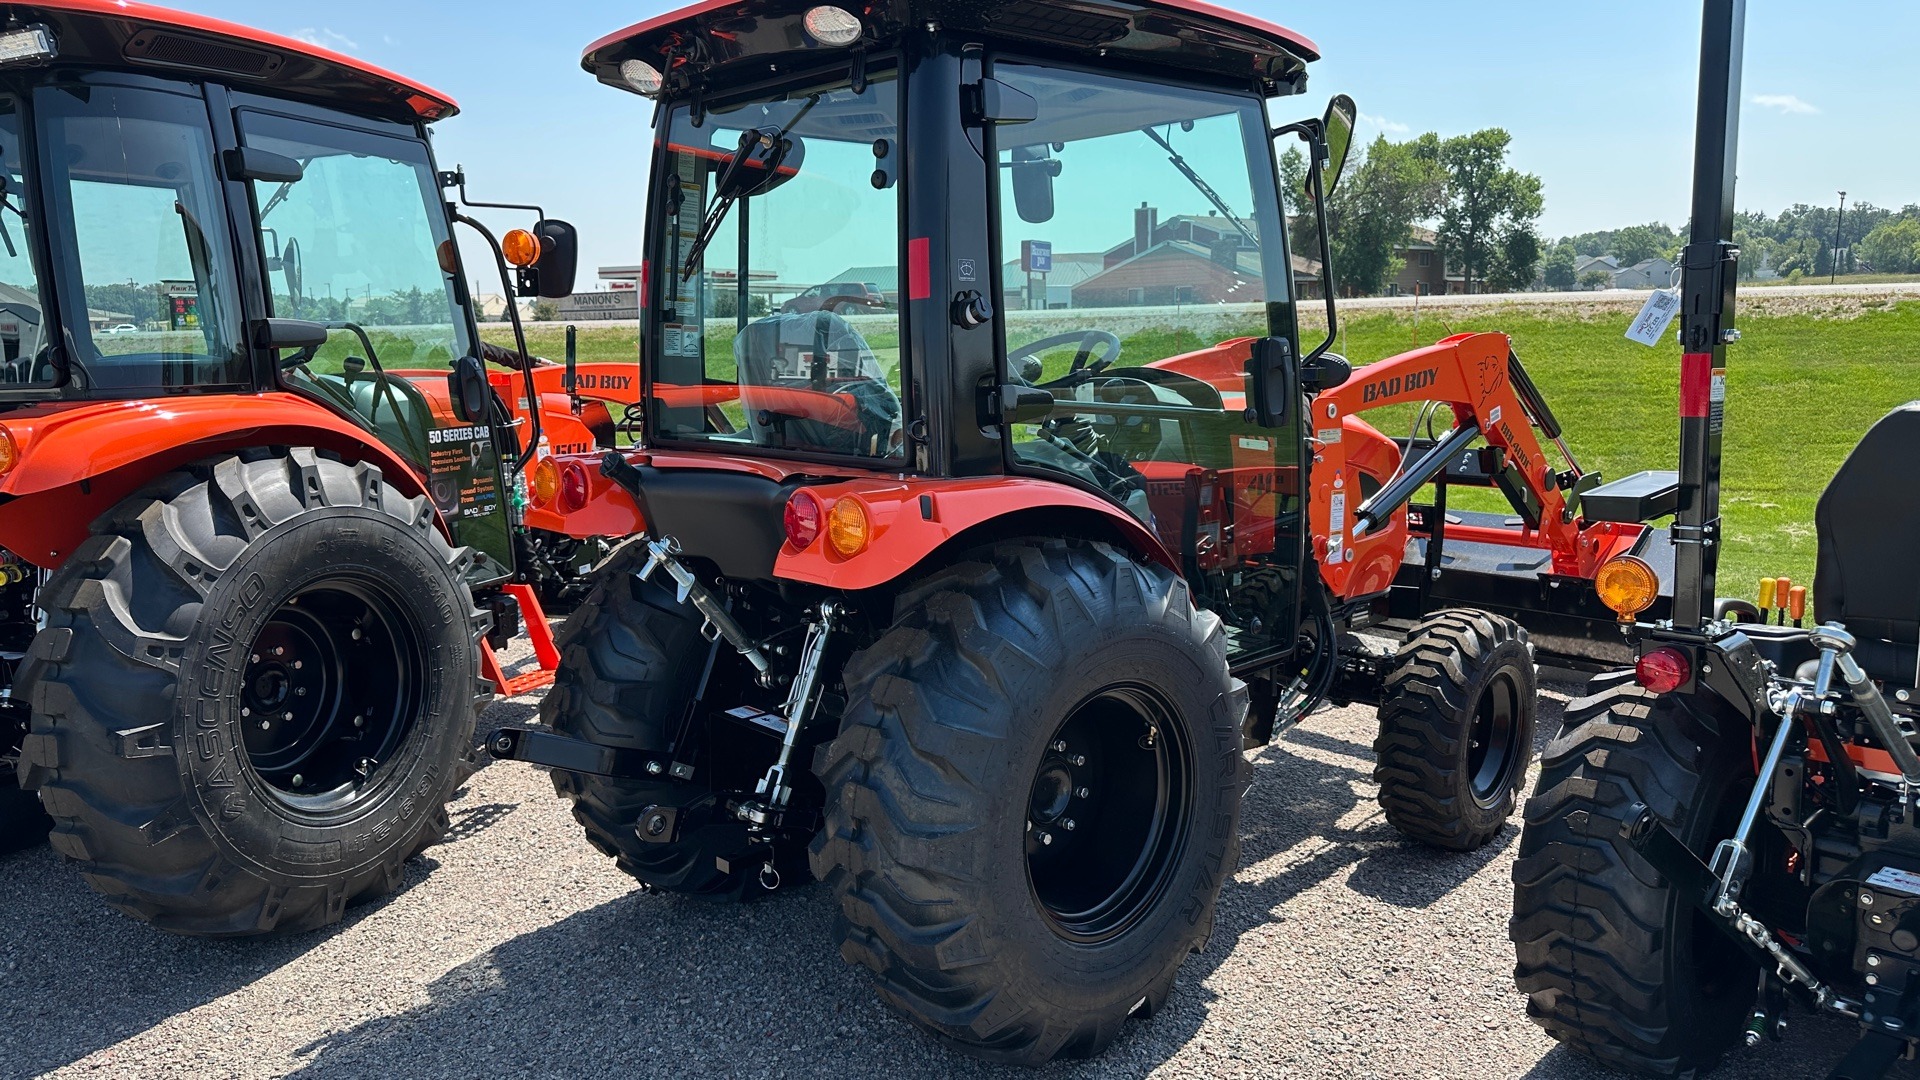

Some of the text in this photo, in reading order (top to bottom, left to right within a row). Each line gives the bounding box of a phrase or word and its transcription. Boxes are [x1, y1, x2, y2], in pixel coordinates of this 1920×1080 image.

[574, 294, 621, 305] MANION'S
[600, 375, 632, 389] BOY
[1363, 367, 1439, 403] BAD BOY
[429, 425, 490, 444] 50 SERIES CAB
[464, 507, 479, 516] BAD
[196, 571, 266, 787] ASCENSO
